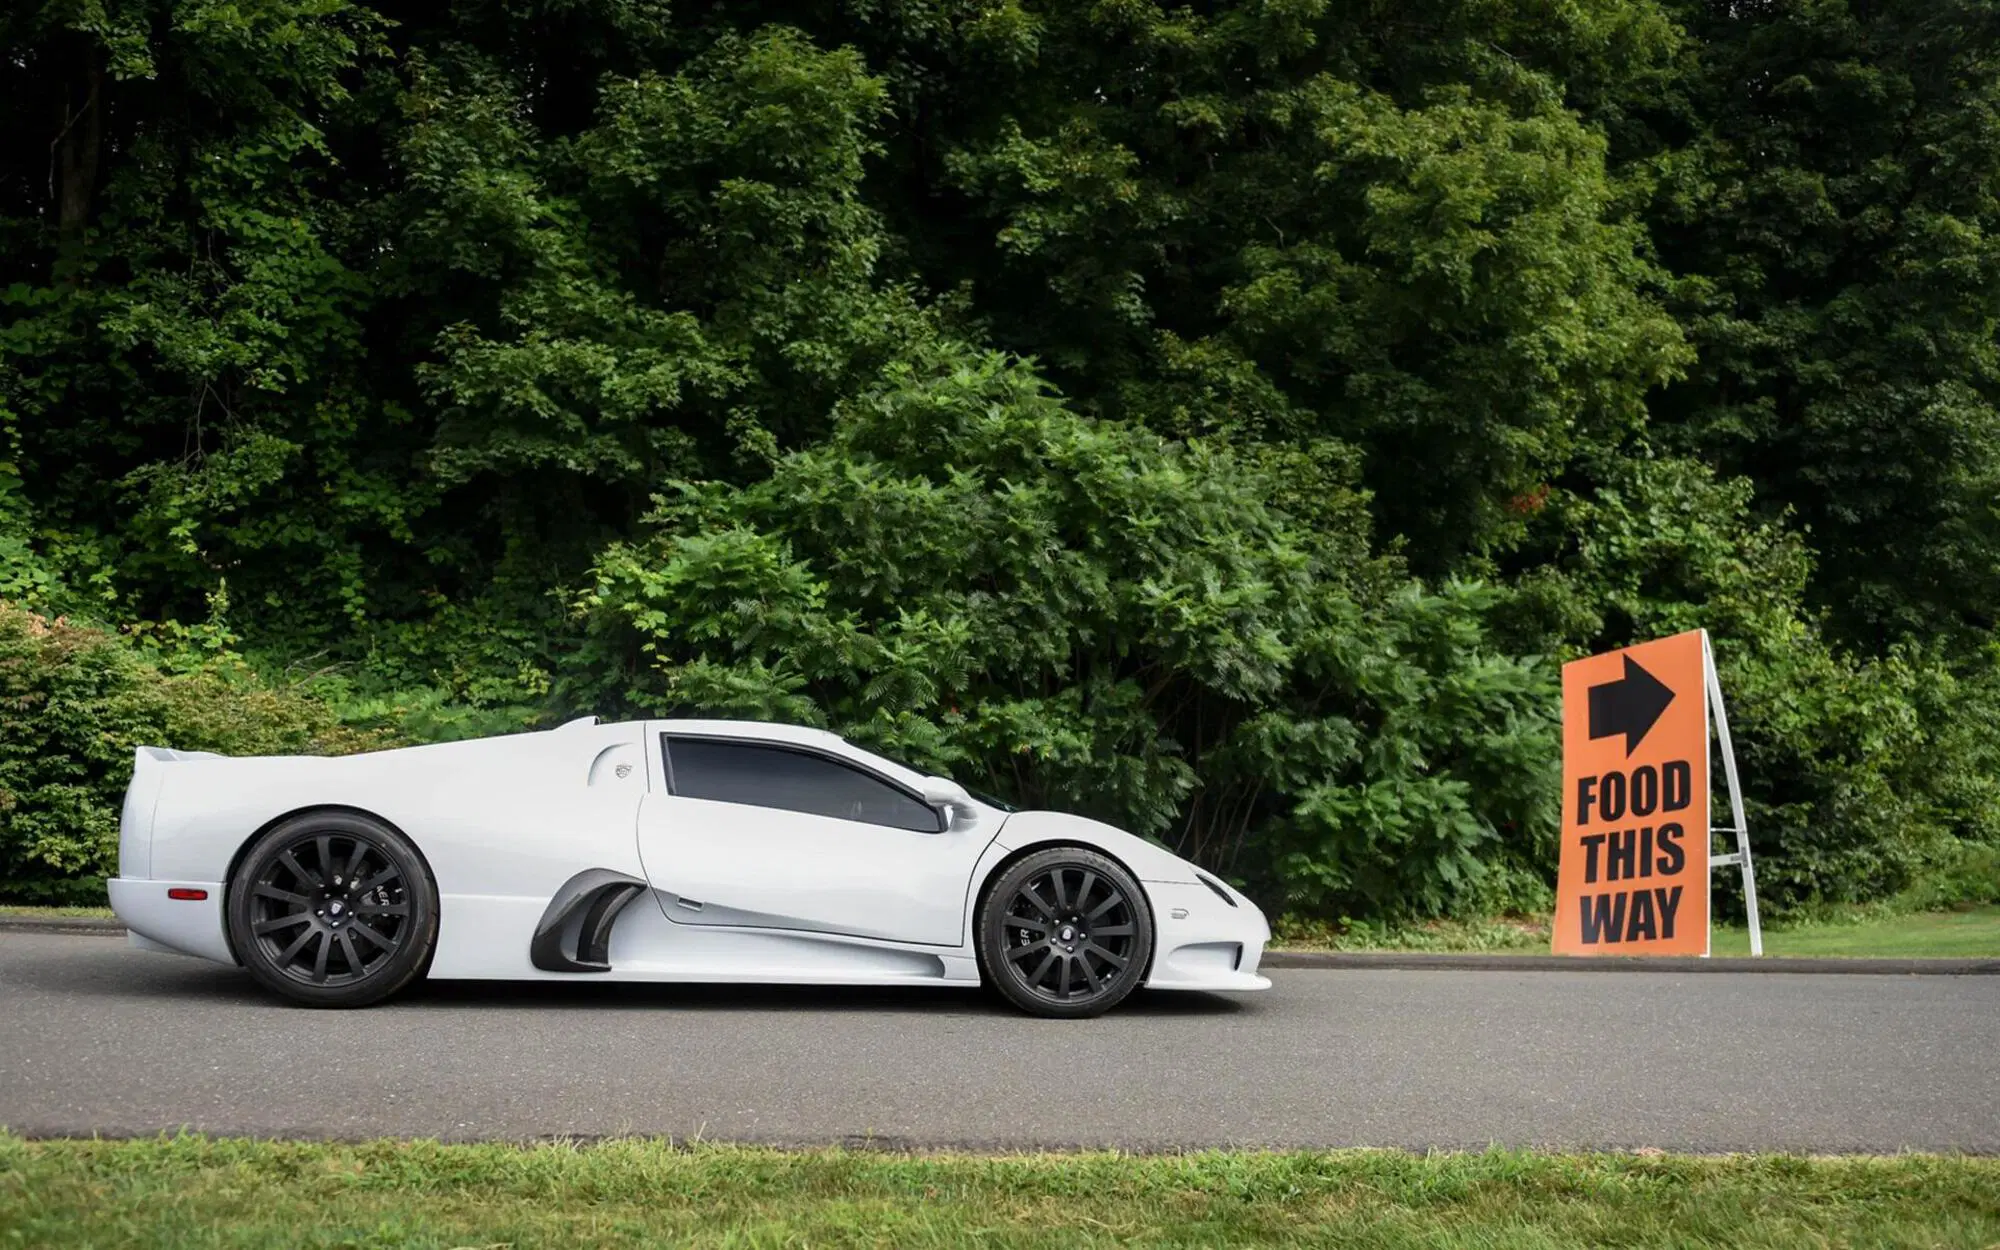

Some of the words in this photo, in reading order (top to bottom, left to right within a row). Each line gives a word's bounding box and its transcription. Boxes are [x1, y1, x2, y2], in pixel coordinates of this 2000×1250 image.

[1577, 760, 1691, 826] FOOD
[1580, 823, 1685, 884] THIS
[1580, 886, 1683, 944] WAY
